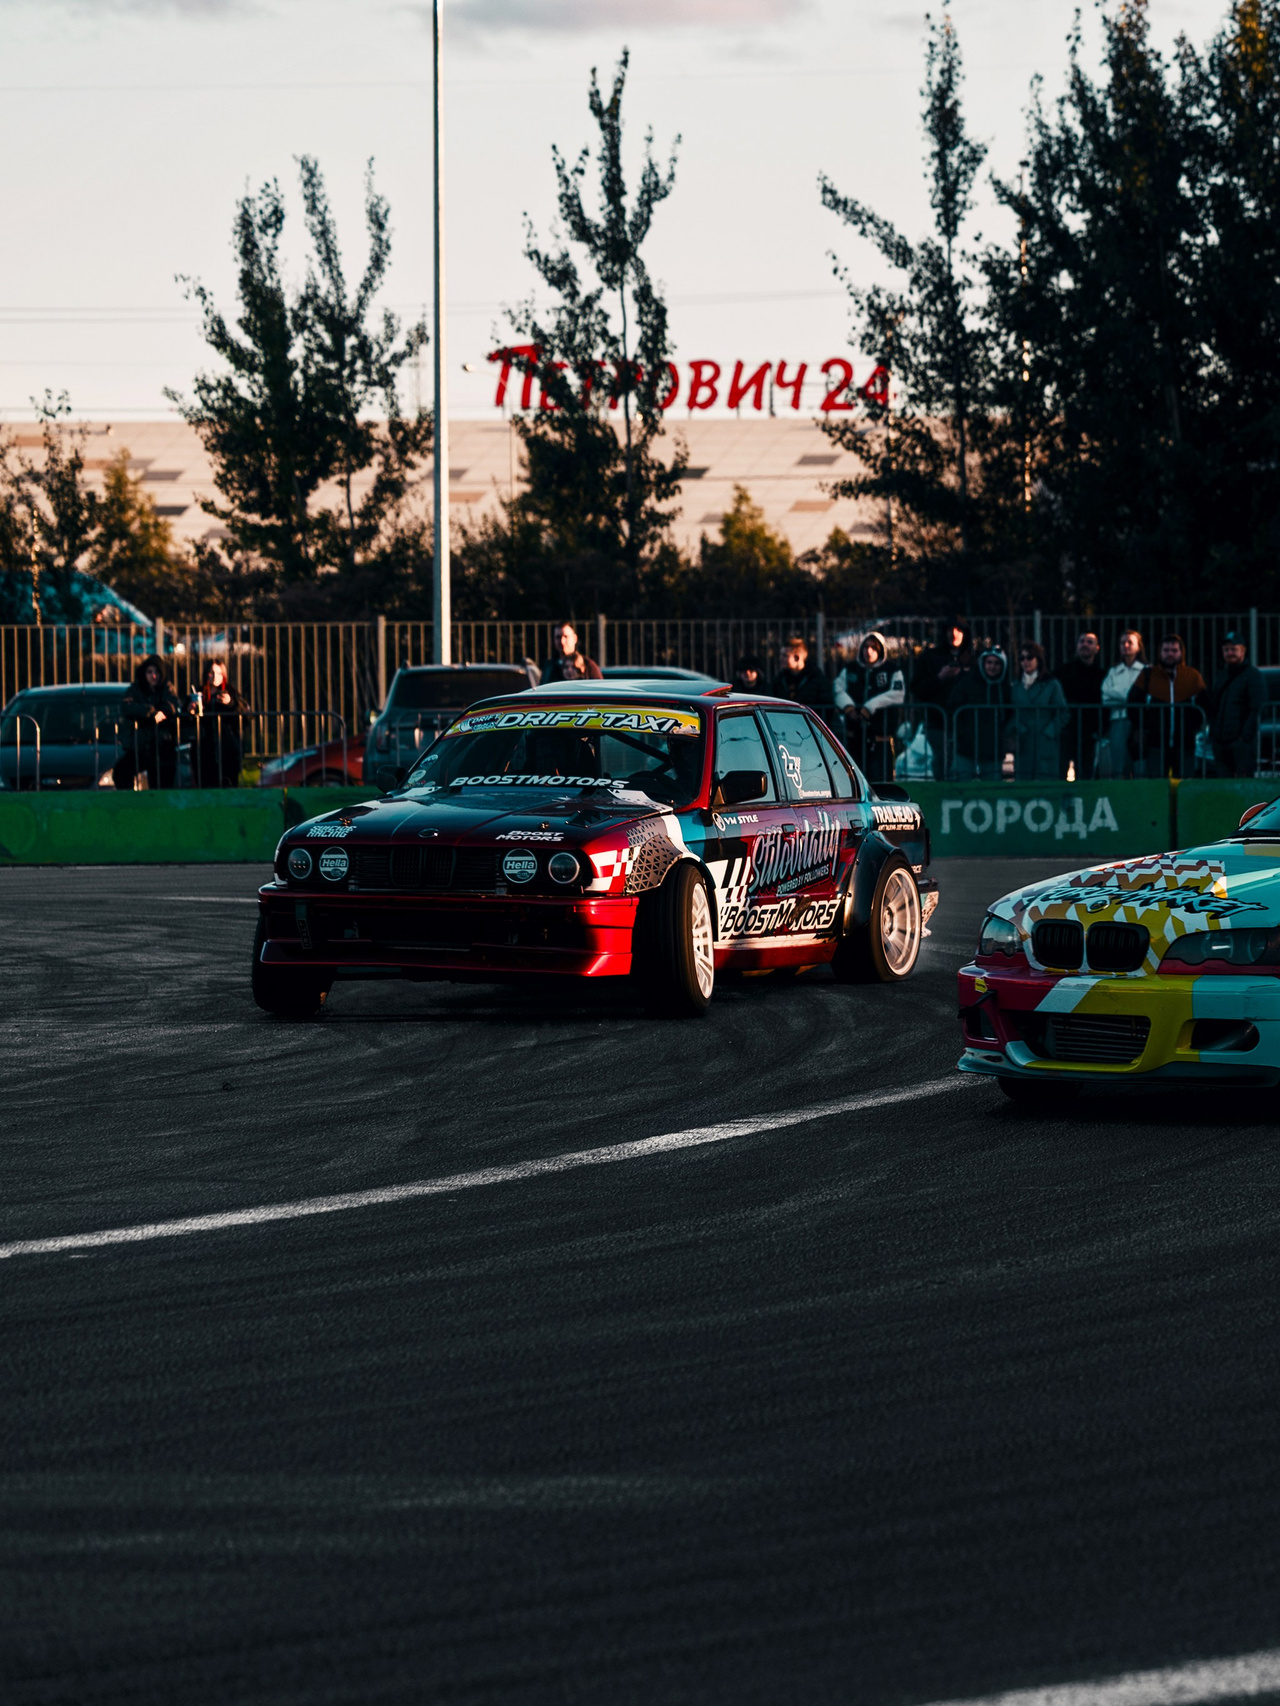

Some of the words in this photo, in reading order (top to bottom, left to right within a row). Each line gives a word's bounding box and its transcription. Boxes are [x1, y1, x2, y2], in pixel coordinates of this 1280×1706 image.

[497, 711, 600, 729] DRIFT
[601, 712, 680, 732] TAXI
[449, 774, 630, 789] BOOSTMOTORS
[737, 814, 759, 824] STYLE
[940, 796, 1119, 840] ГОРОДА
[495, 834, 565, 842] MOTORS
[321, 858, 348, 868] Hella
[506, 860, 535, 870] Hella
[777, 876, 799, 894] POWERED
[804, 864, 830, 884] FOLLOWERS
